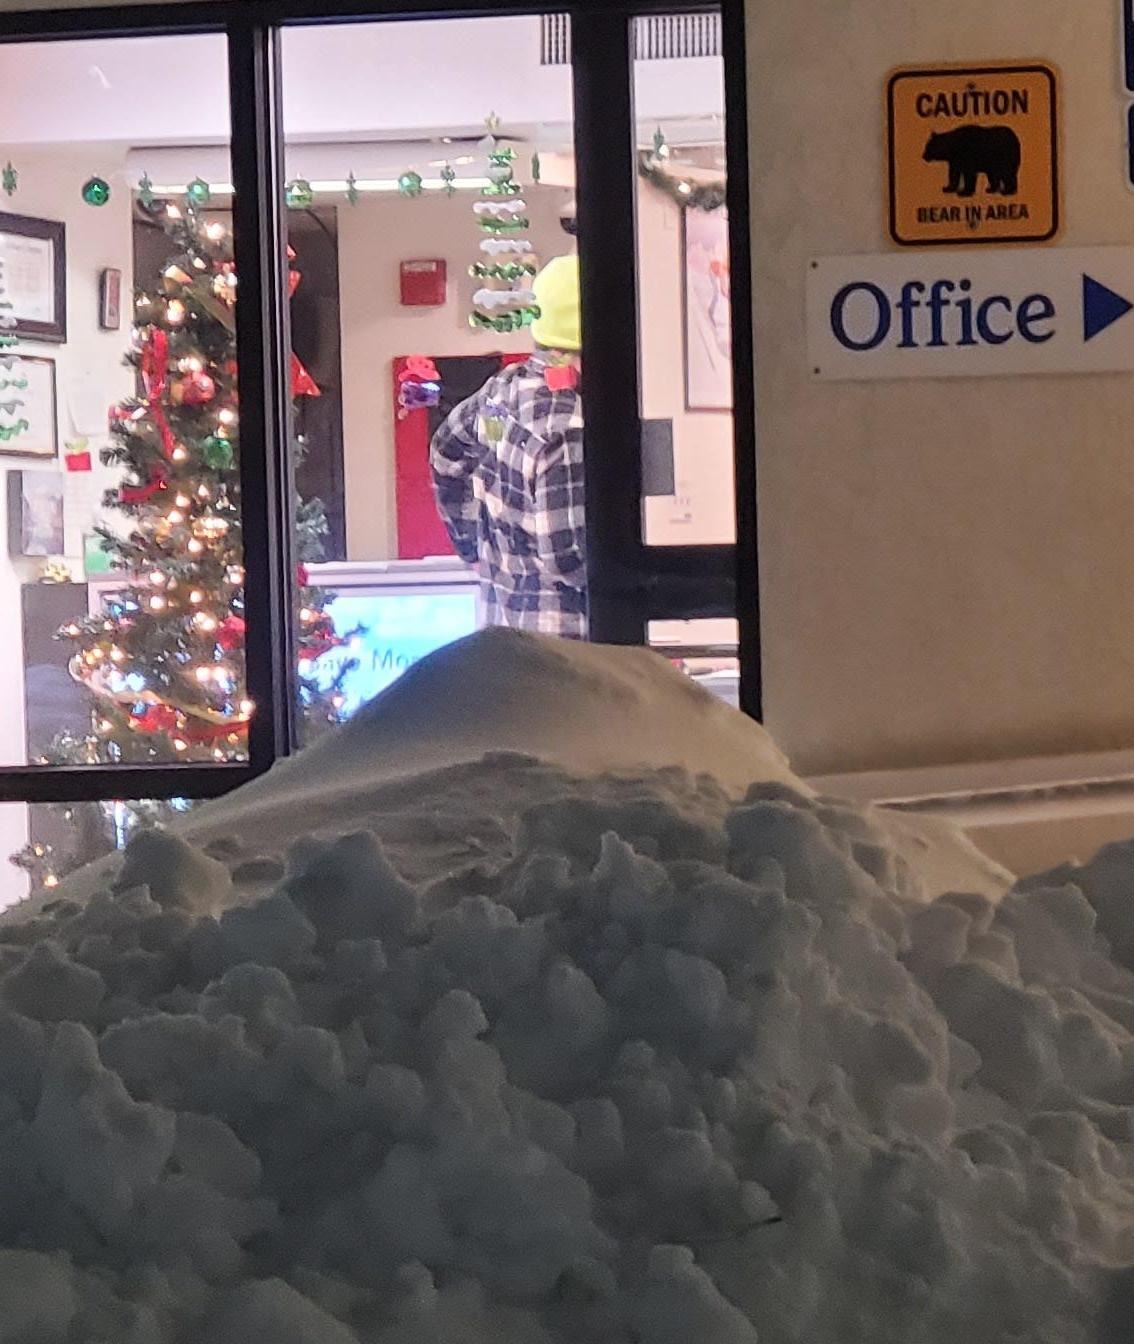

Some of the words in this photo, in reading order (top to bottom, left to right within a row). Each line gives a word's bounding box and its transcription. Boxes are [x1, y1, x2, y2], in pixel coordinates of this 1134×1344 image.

[915, 89, 1029, 118] CAUTION
[917, 206, 961, 223] BEAR
[965, 205, 981, 221] IN
[985, 203, 1029, 220] AREA
[830, 278, 1056, 351] Office
